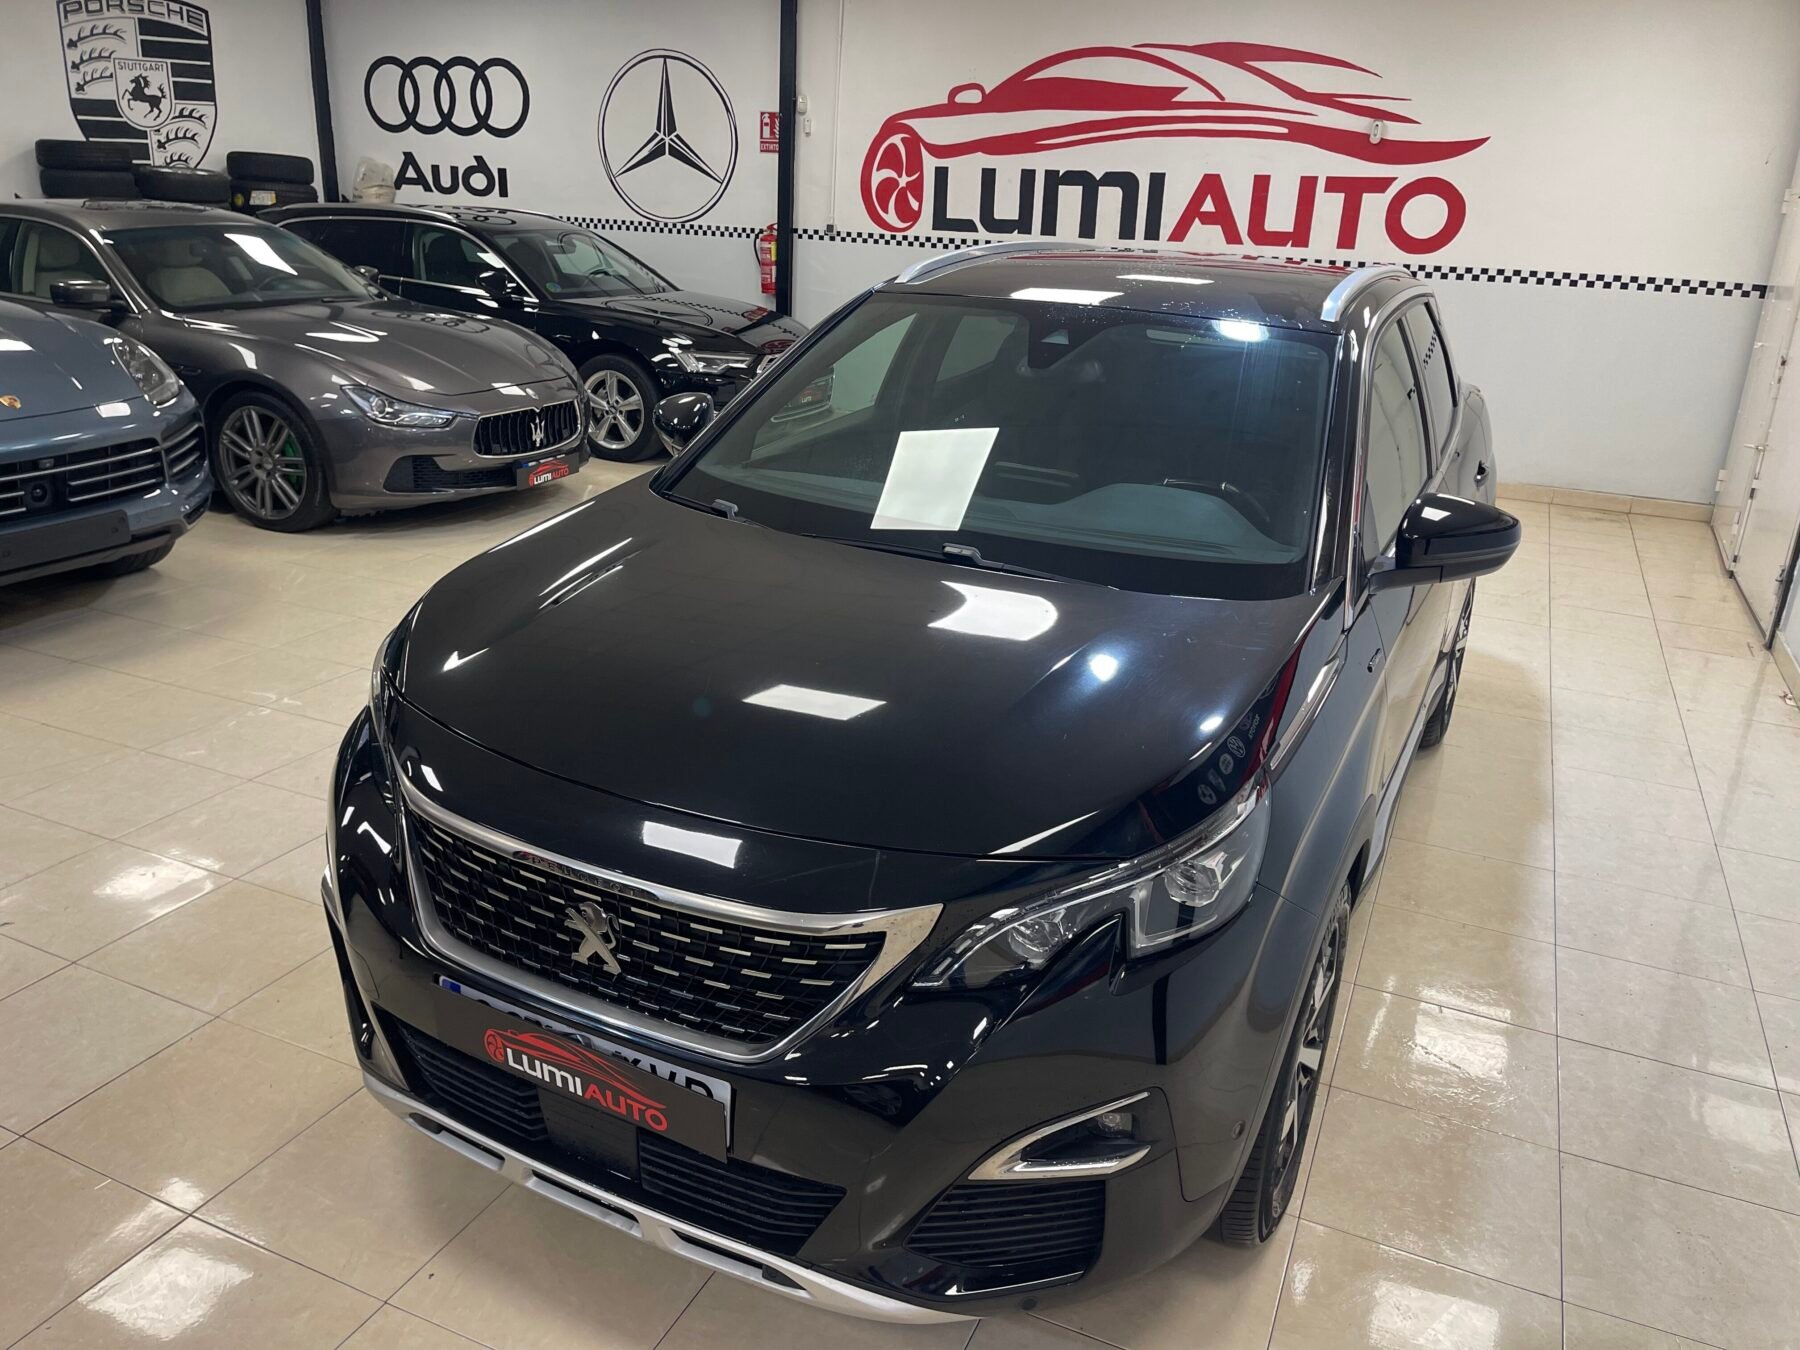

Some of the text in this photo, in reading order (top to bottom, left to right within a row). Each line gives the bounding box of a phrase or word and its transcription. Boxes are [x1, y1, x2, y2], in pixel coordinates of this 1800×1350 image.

[63, 0, 206, 31] PORSCHE
[117, 61, 164, 72] STUTTGART
[760, 143, 779, 151] EXTINTO
[394, 151, 508, 198] Audi
[932, 166, 1466, 254] LUMIAUTO
[506, 1048, 668, 1132] LUMIAUTO
